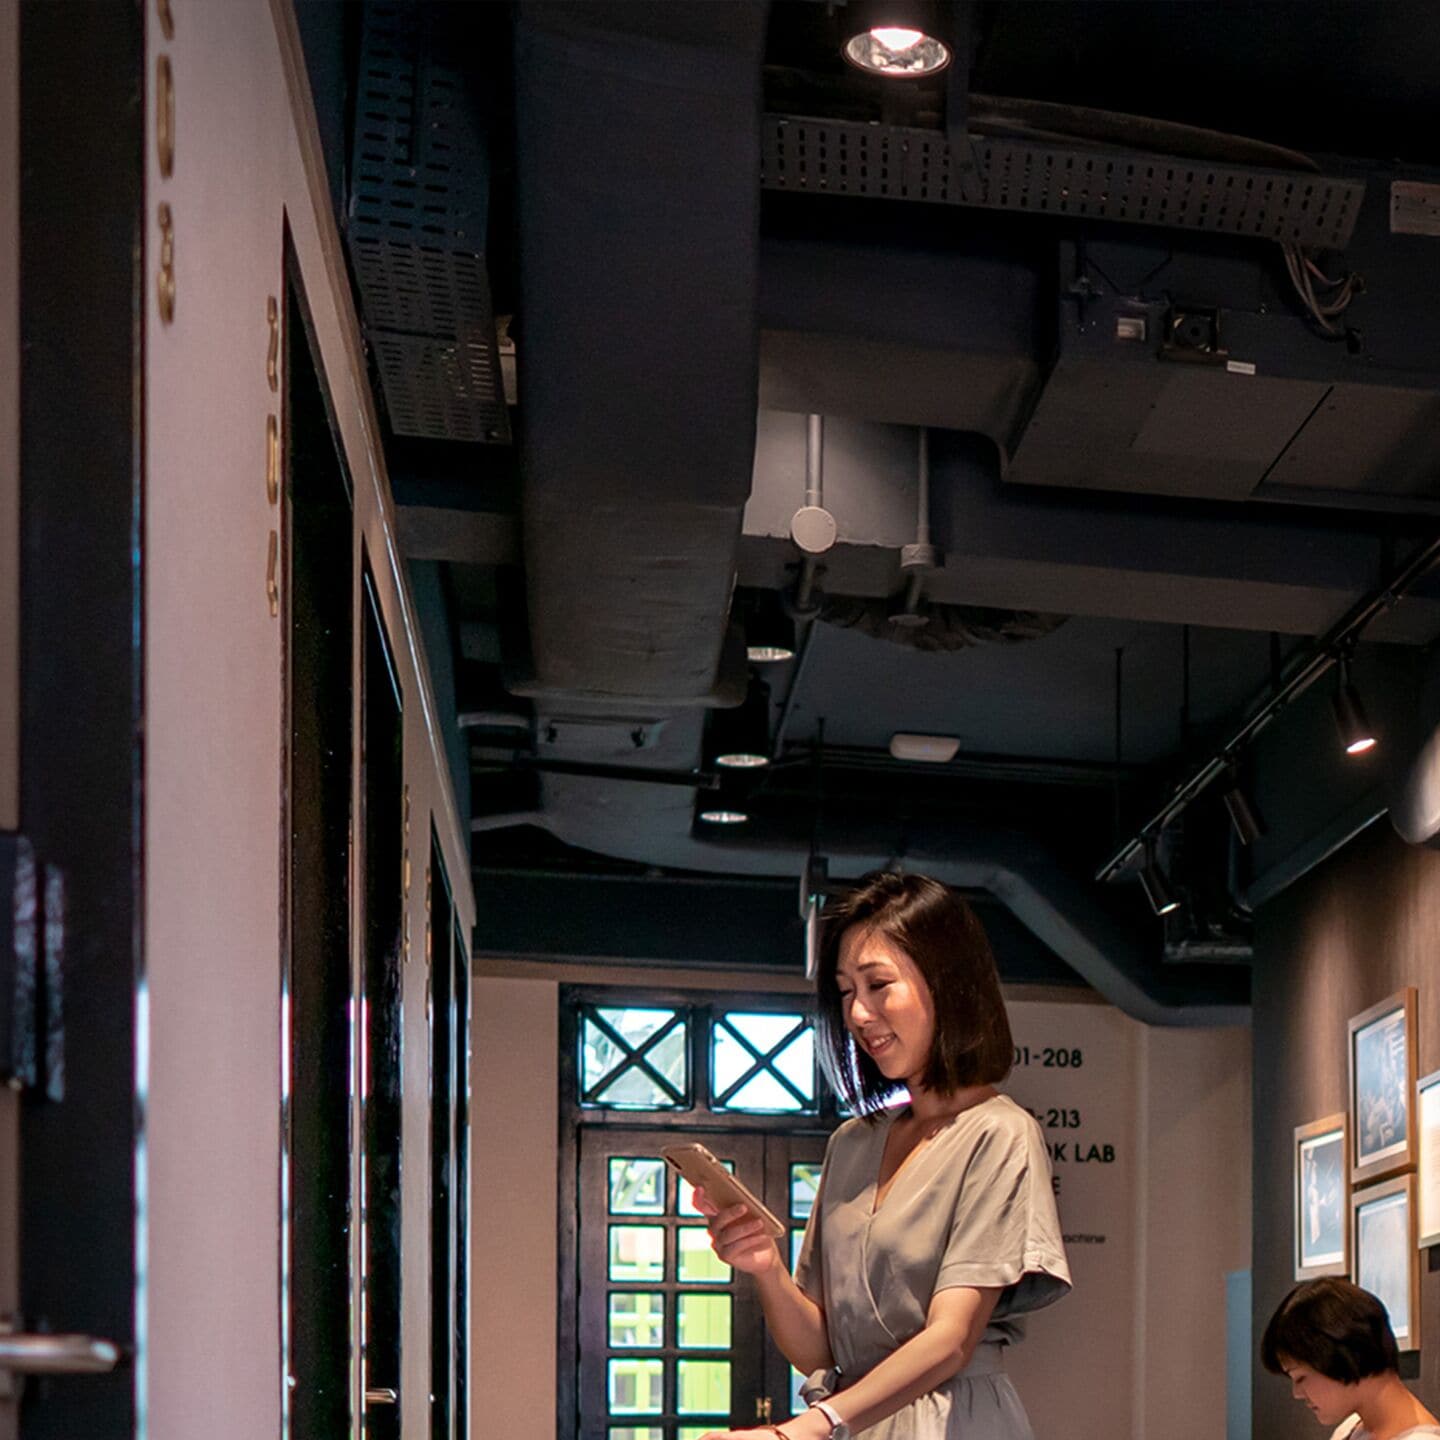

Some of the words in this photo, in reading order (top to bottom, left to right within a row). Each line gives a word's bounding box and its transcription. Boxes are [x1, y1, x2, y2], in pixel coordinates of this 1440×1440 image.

[1025, 1107, 1081, 1129] -213
[1046, 1142, 1067, 1163] K
[1075, 1143, 1116, 1163] LAB
[1062, 1232, 1106, 1244] achine
